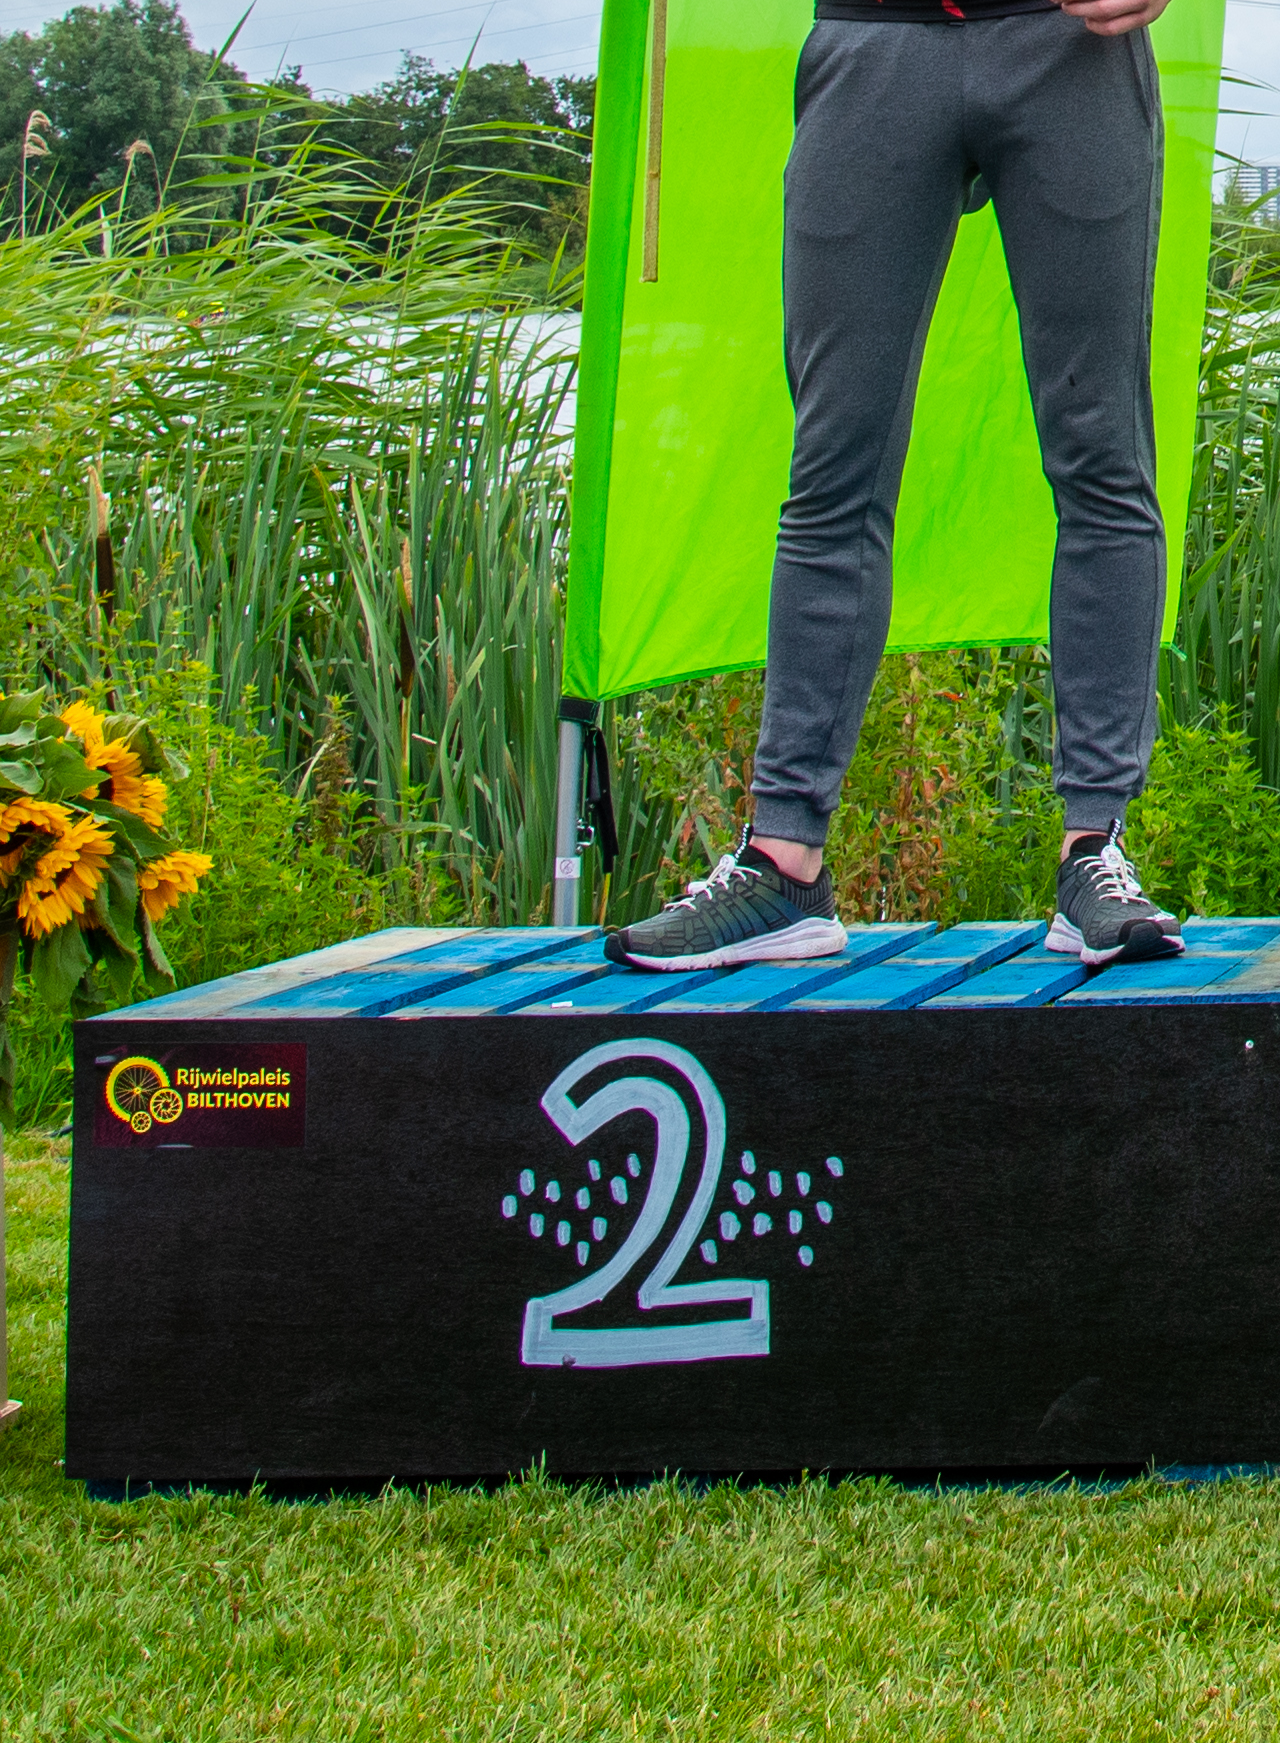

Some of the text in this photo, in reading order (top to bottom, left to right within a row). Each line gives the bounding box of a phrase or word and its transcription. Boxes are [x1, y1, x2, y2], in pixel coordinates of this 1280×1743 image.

[176, 1067, 291, 1089] Rijwielpaleis
[186, 1092, 291, 1110] BILTHOVEN
[521, 1037, 770, 1368] 2
